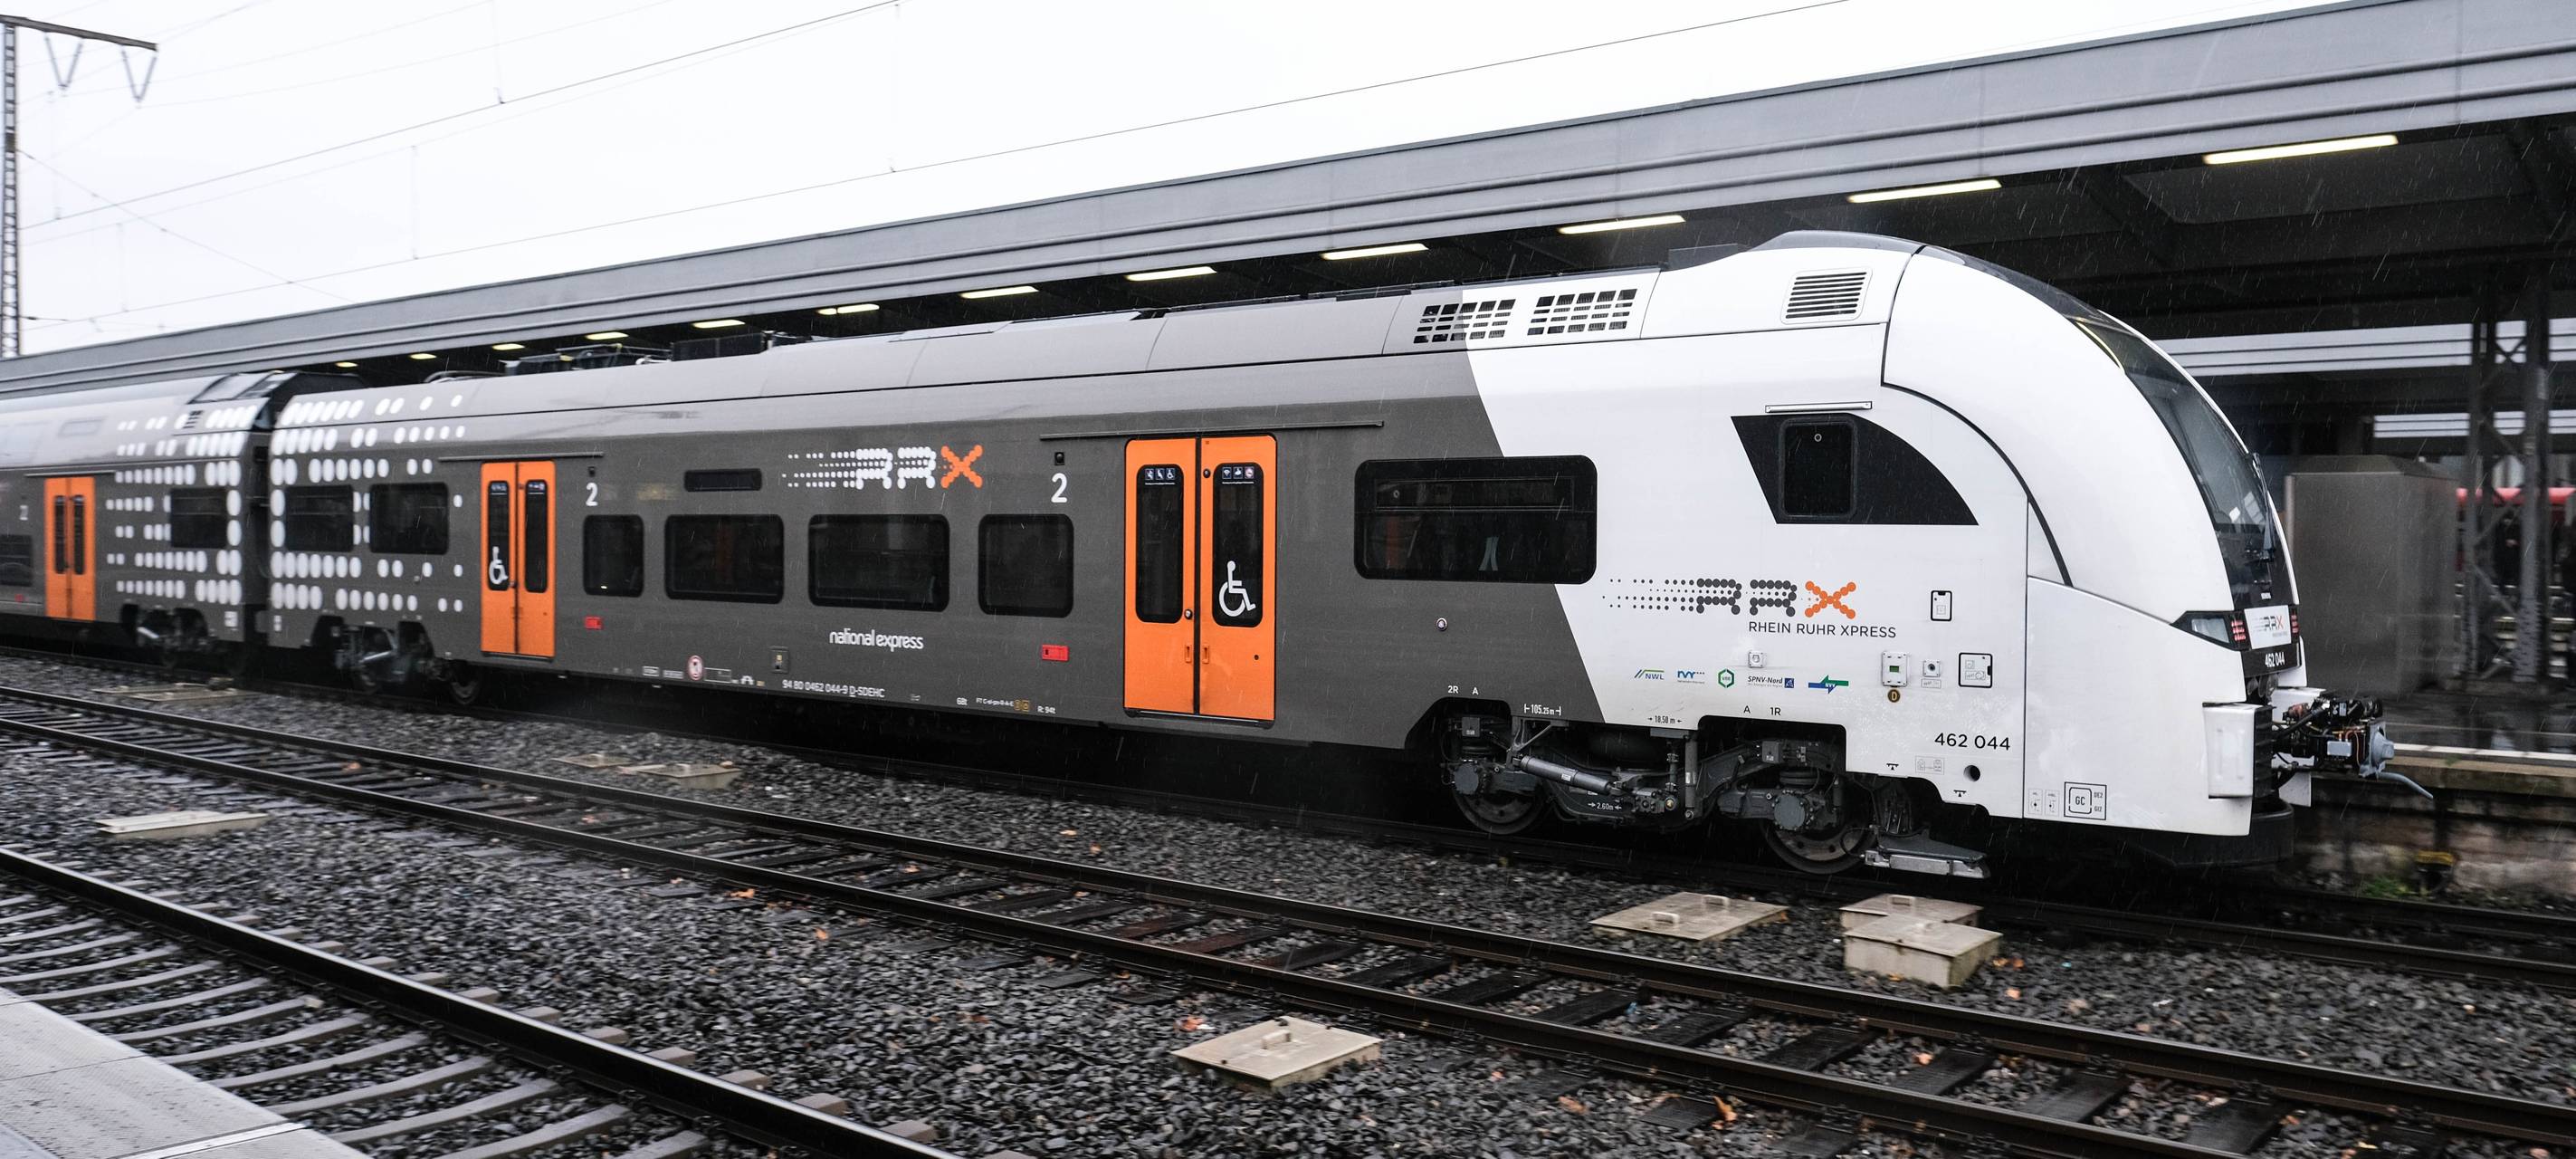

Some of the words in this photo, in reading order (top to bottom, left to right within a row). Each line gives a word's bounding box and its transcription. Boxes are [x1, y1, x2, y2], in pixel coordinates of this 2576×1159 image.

[855, 444, 984, 490] RRX
[586, 482, 598, 507] 2
[1051, 473, 1068, 503] 2
[1695, 578, 1856, 619] RRX
[1748, 621, 1792, 635] RHEIN
[1796, 623, 1837, 637] RUHR
[1840, 625, 1897, 639] XPRESS
[829, 627, 875, 647] national
[876, 633, 924, 652] express
[2265, 653, 2275, 668] 462
[2275, 652, 2285, 666] 044
[782, 679, 793, 689] 94
[805, 682, 825, 693] 0462
[1747, 675, 1783, 685] SPNV-Nord
[1447, 685, 1459, 694] 2R
[1472, 687, 1479, 695] A
[1743, 705, 1751, 714] A
[1770, 707, 1781, 716] 1R
[1934, 733, 1968, 748] 462
[1974, 735, 2011, 751] 044
[2075, 796, 2085, 806] GC
